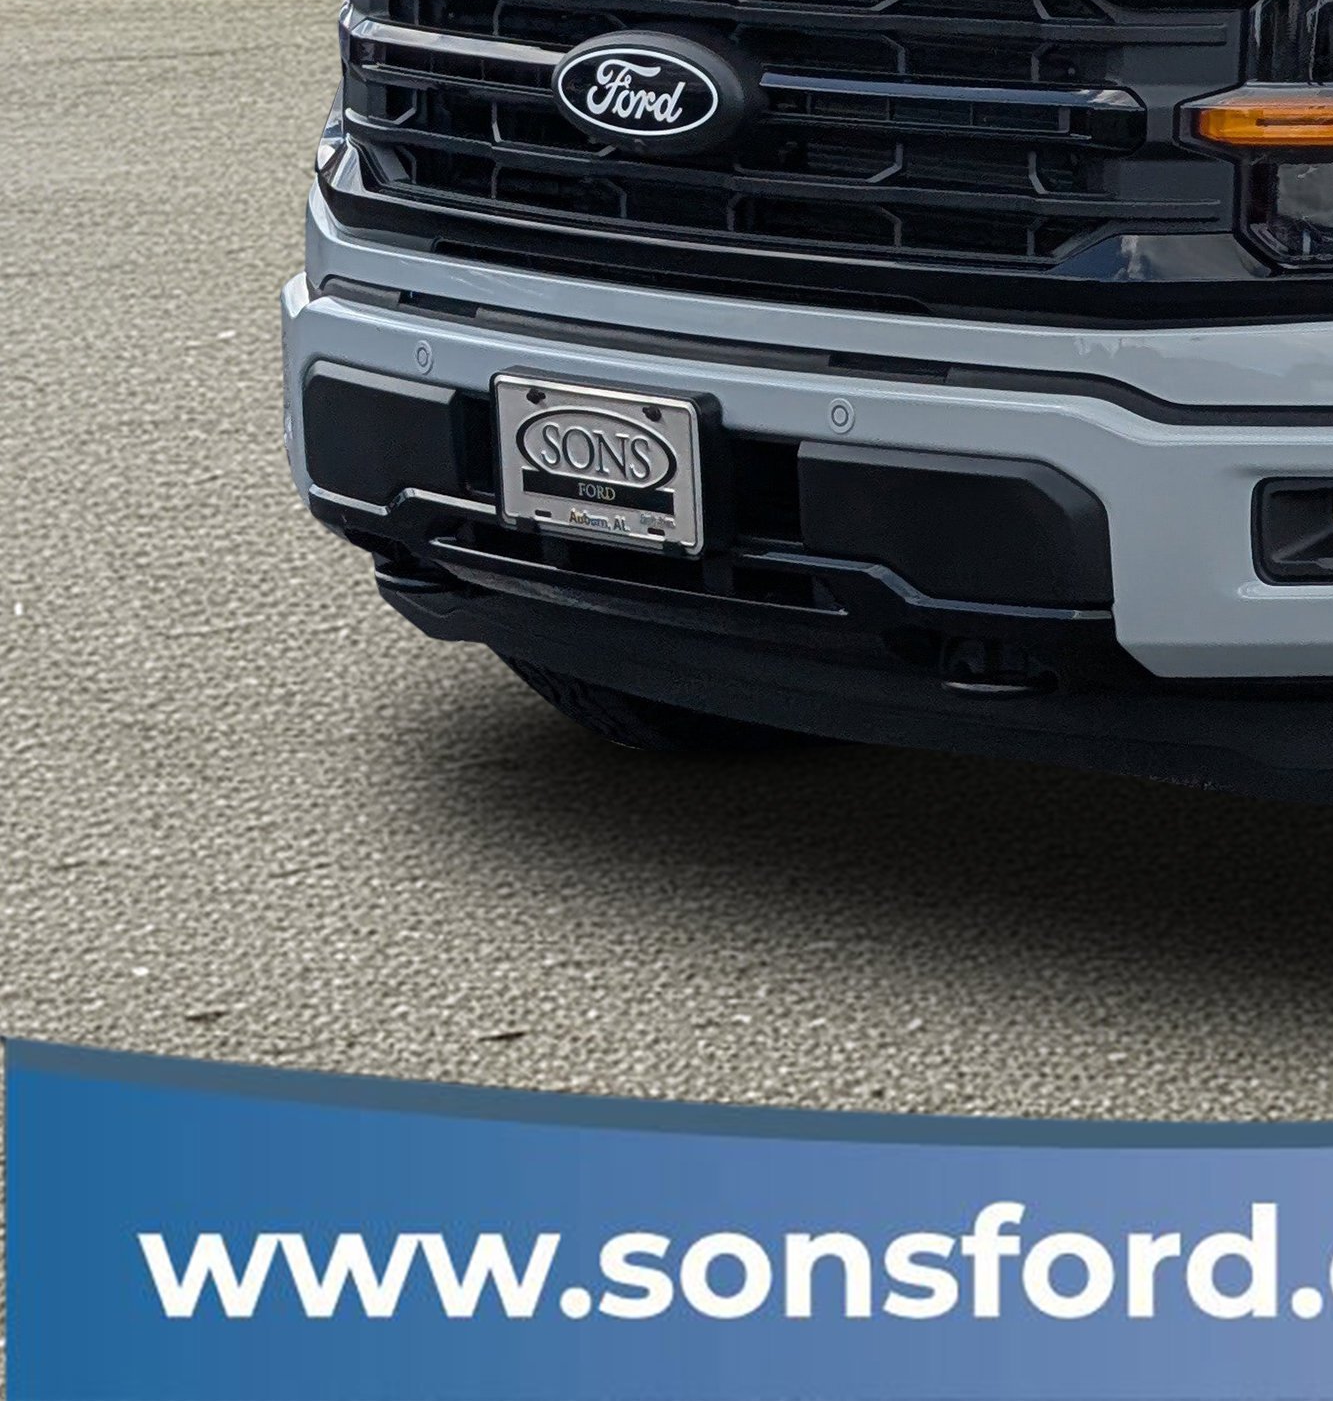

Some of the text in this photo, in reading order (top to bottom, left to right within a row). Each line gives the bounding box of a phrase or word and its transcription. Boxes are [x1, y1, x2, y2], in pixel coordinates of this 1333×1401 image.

[586, 58, 687, 124] Ford
[540, 421, 651, 481] SONS
[578, 482, 616, 500] FORD
